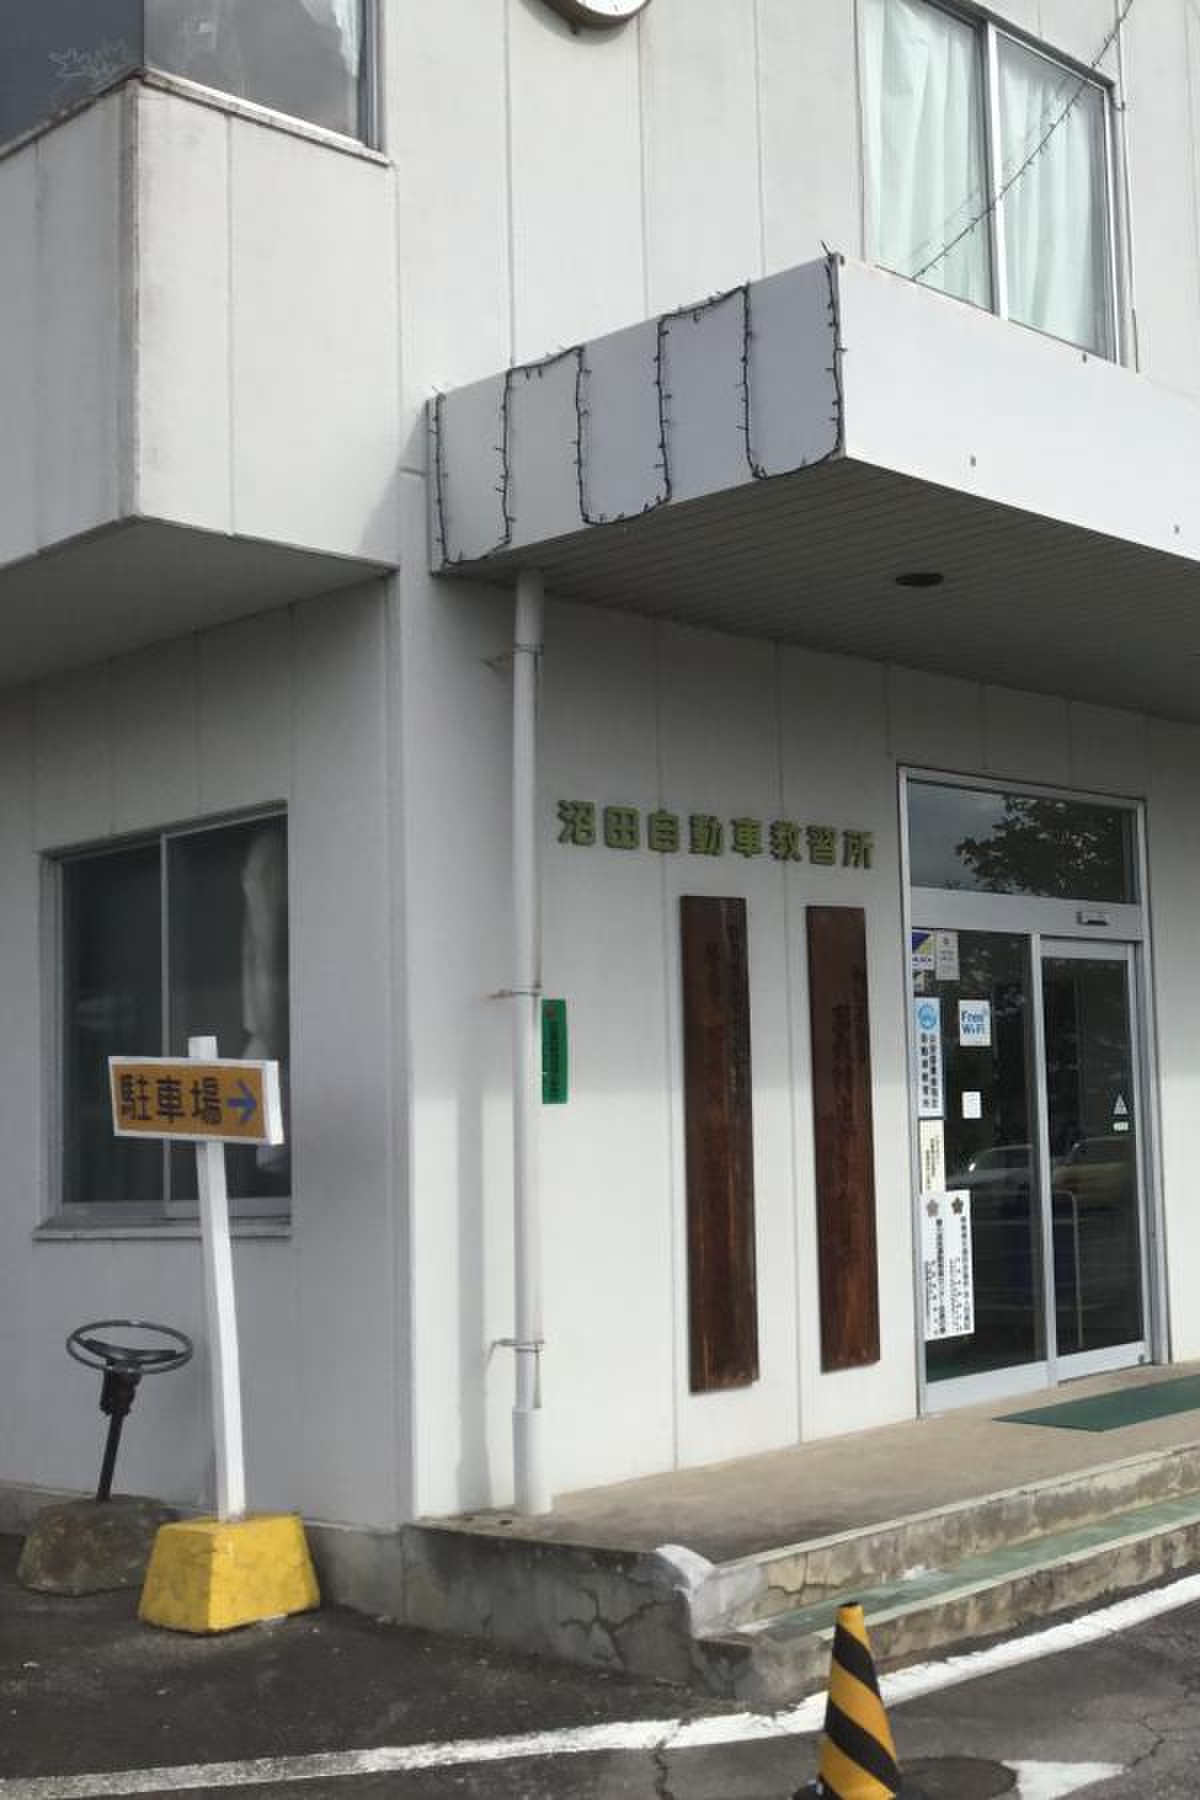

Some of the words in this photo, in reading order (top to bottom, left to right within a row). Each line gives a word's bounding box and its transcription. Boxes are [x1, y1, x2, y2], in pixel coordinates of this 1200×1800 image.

[557, 800, 875, 869] 沼田自動車教習所
[120, 1074, 222, 1125] 駐車場
